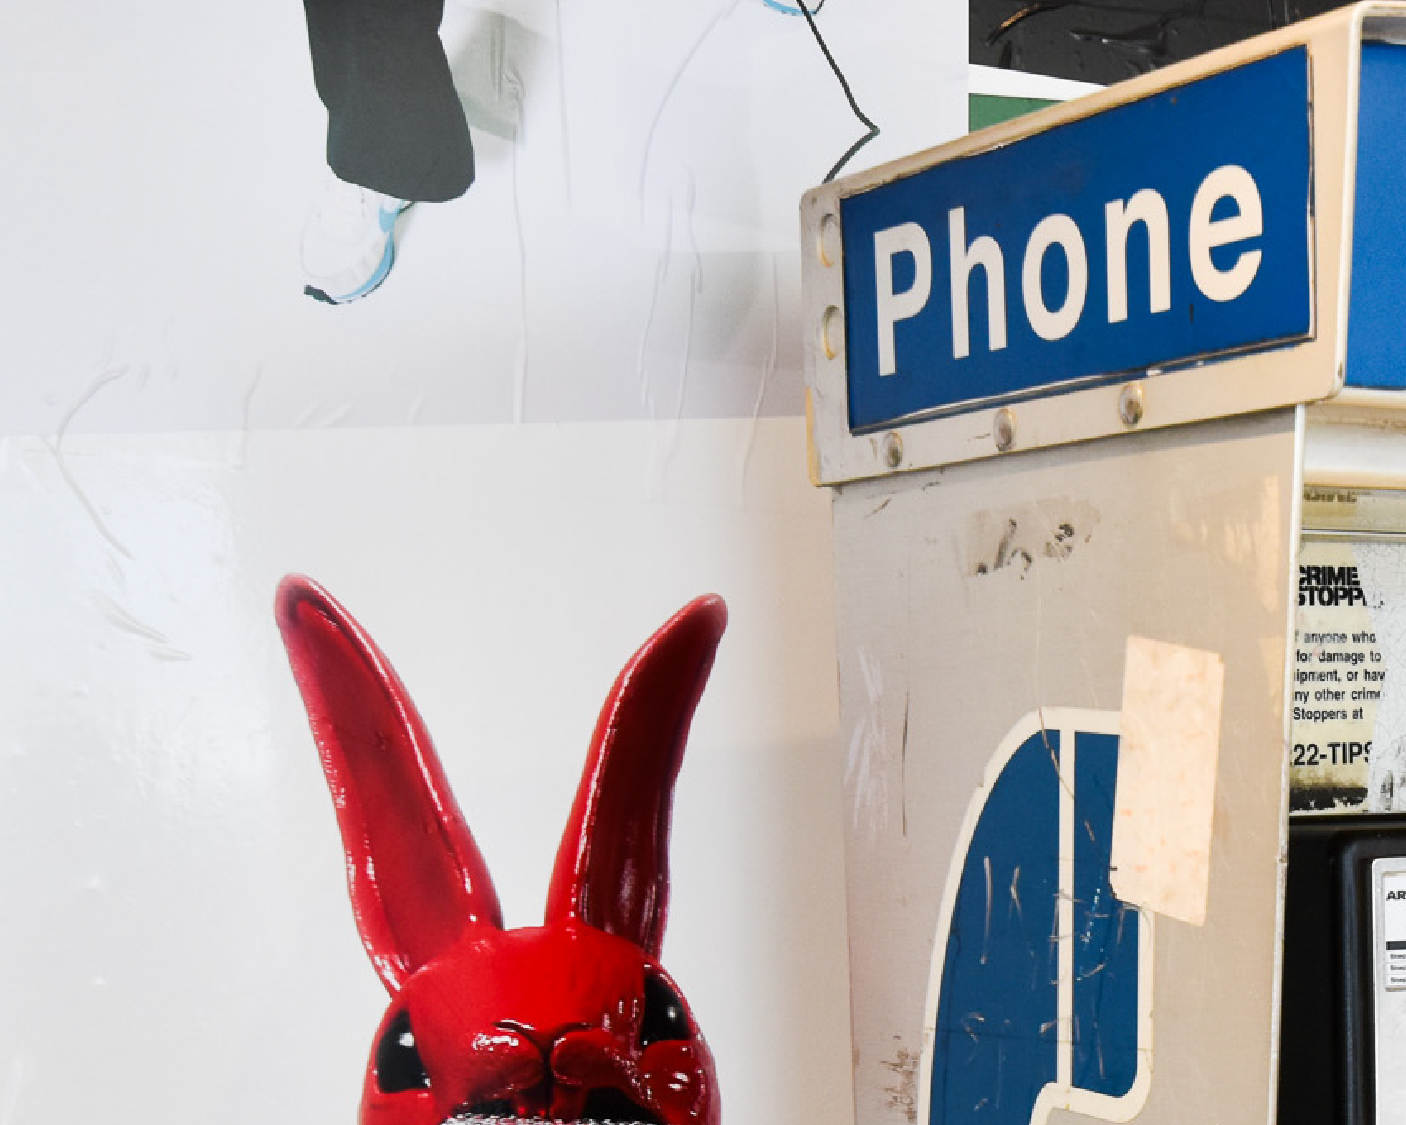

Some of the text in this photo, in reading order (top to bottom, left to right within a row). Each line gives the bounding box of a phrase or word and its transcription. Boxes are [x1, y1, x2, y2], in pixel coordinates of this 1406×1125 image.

[873, 164, 1264, 377] Phone
[1298, 586, 1367, 606] STOPP
[1304, 632, 1347, 647] anyone
[1318, 650, 1366, 665] damage
[1370, 651, 1382, 662] to
[1347, 671, 1358, 681] or
[1314, 687, 1346, 701] other
[1292, 706, 1364, 724] Stoppers at
